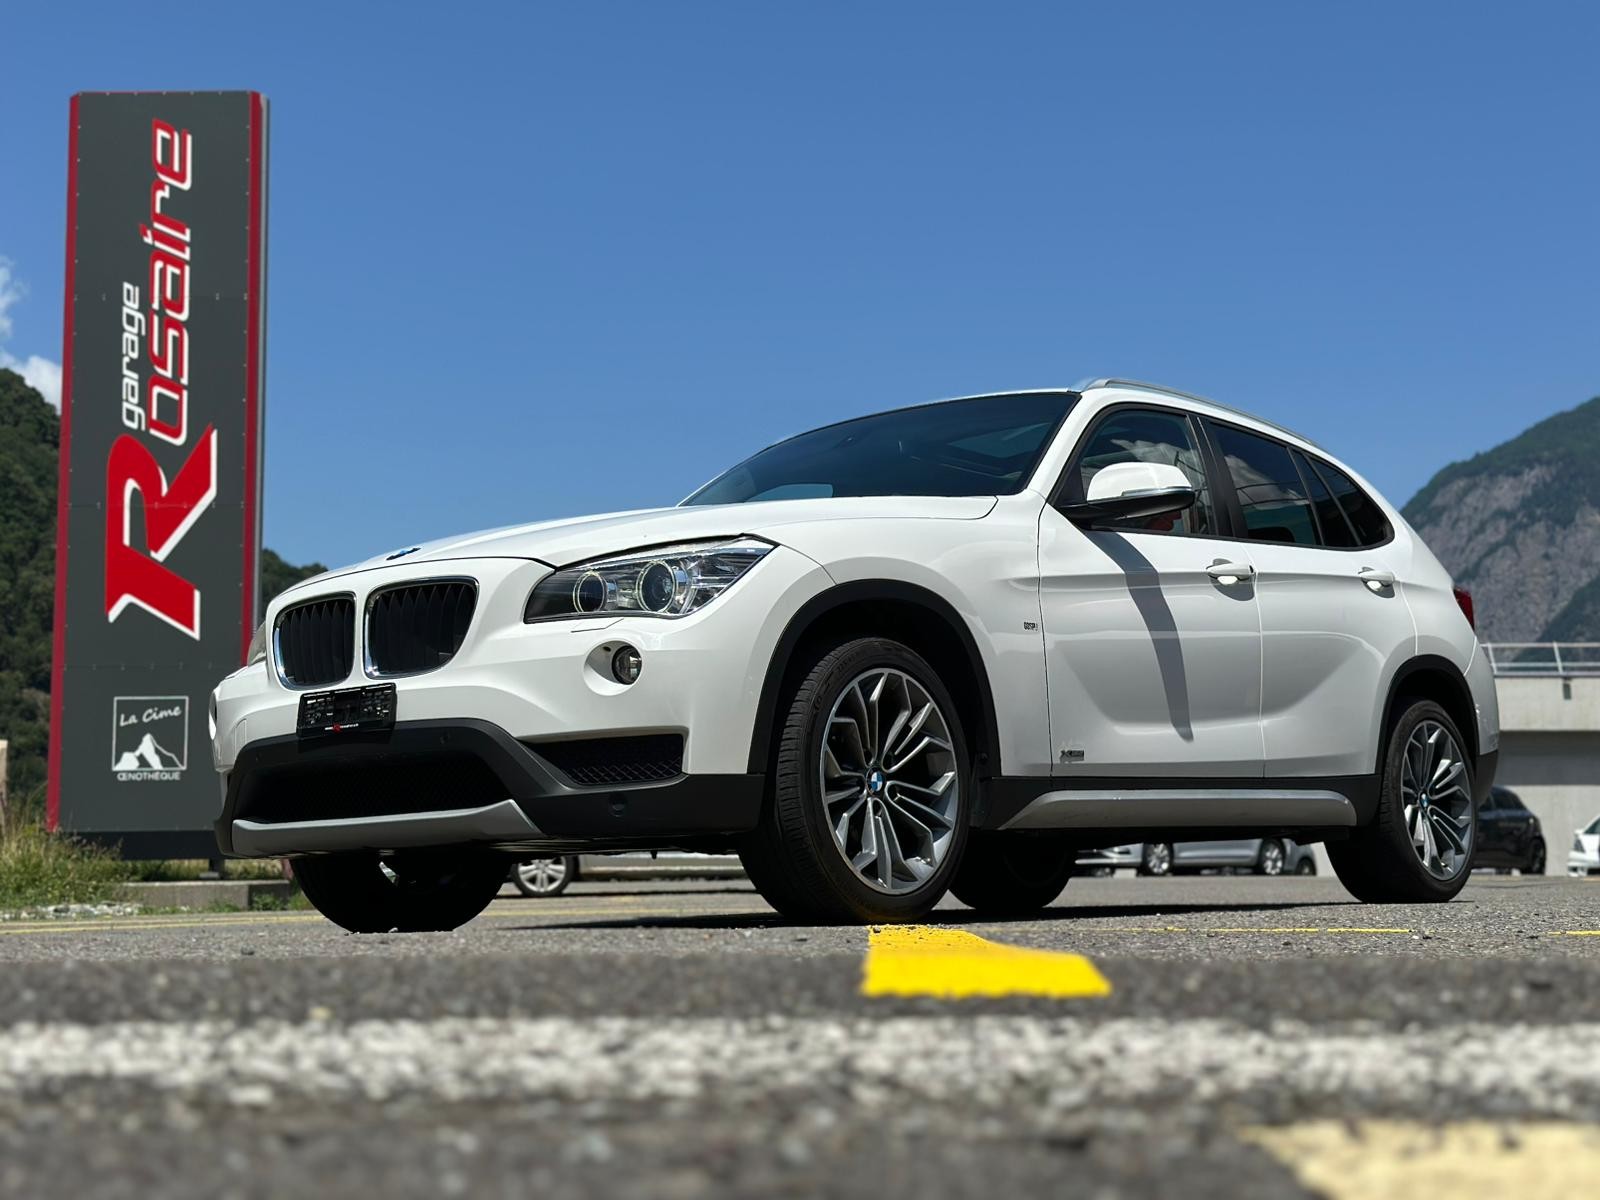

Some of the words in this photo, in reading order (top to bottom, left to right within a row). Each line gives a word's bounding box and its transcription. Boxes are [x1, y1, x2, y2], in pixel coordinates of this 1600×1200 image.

[122, 281, 146, 431] garage
[119, 713, 138, 727] La
[142, 706, 182, 723] Cime
